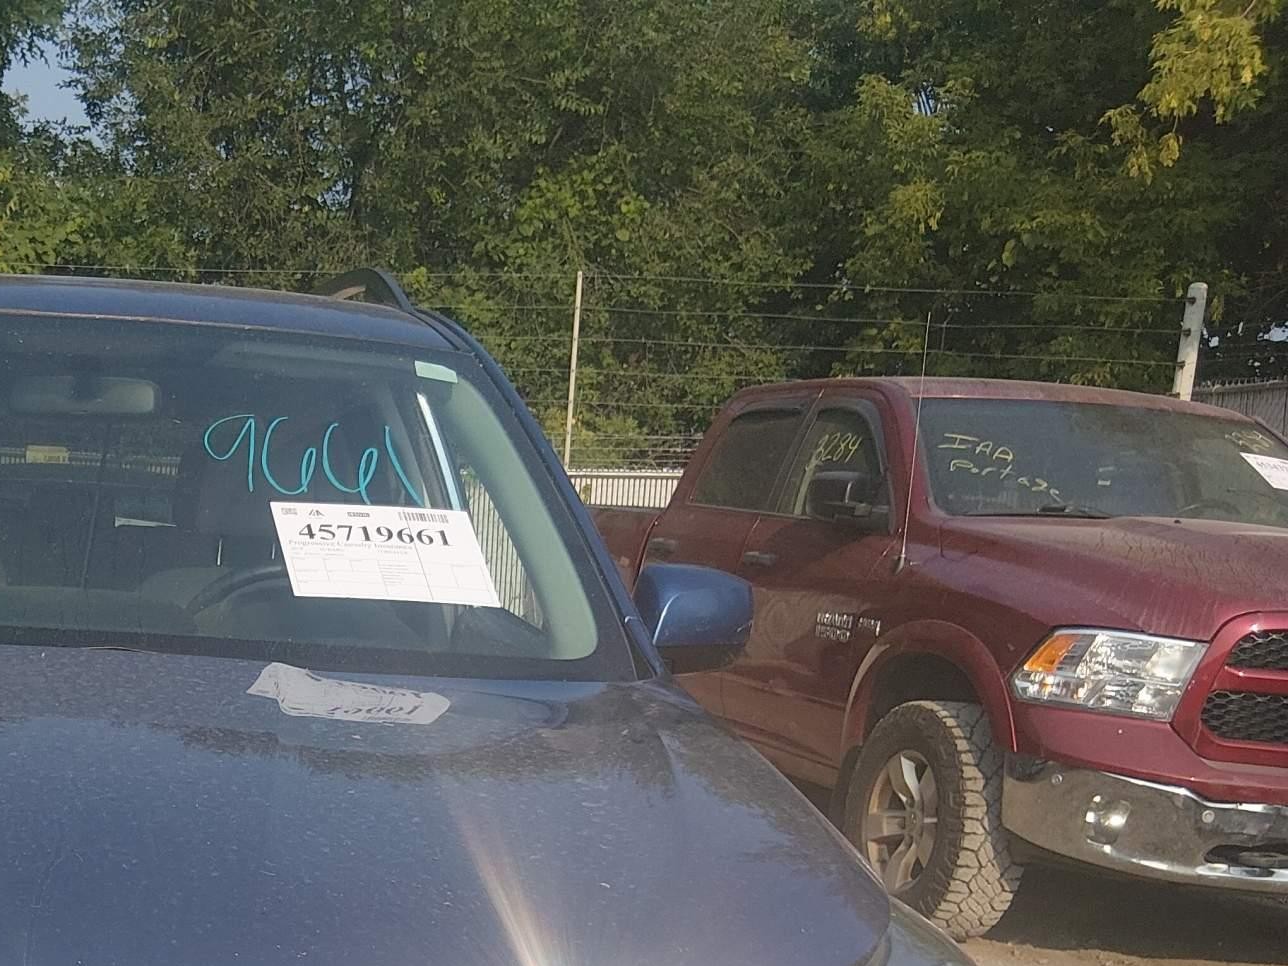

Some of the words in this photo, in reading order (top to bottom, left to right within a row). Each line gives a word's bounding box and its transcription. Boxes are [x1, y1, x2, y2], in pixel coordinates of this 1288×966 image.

[204, 414, 426, 507] 9661
[937, 433, 1014, 463] IAA
[298, 523, 453, 547] 45719661
